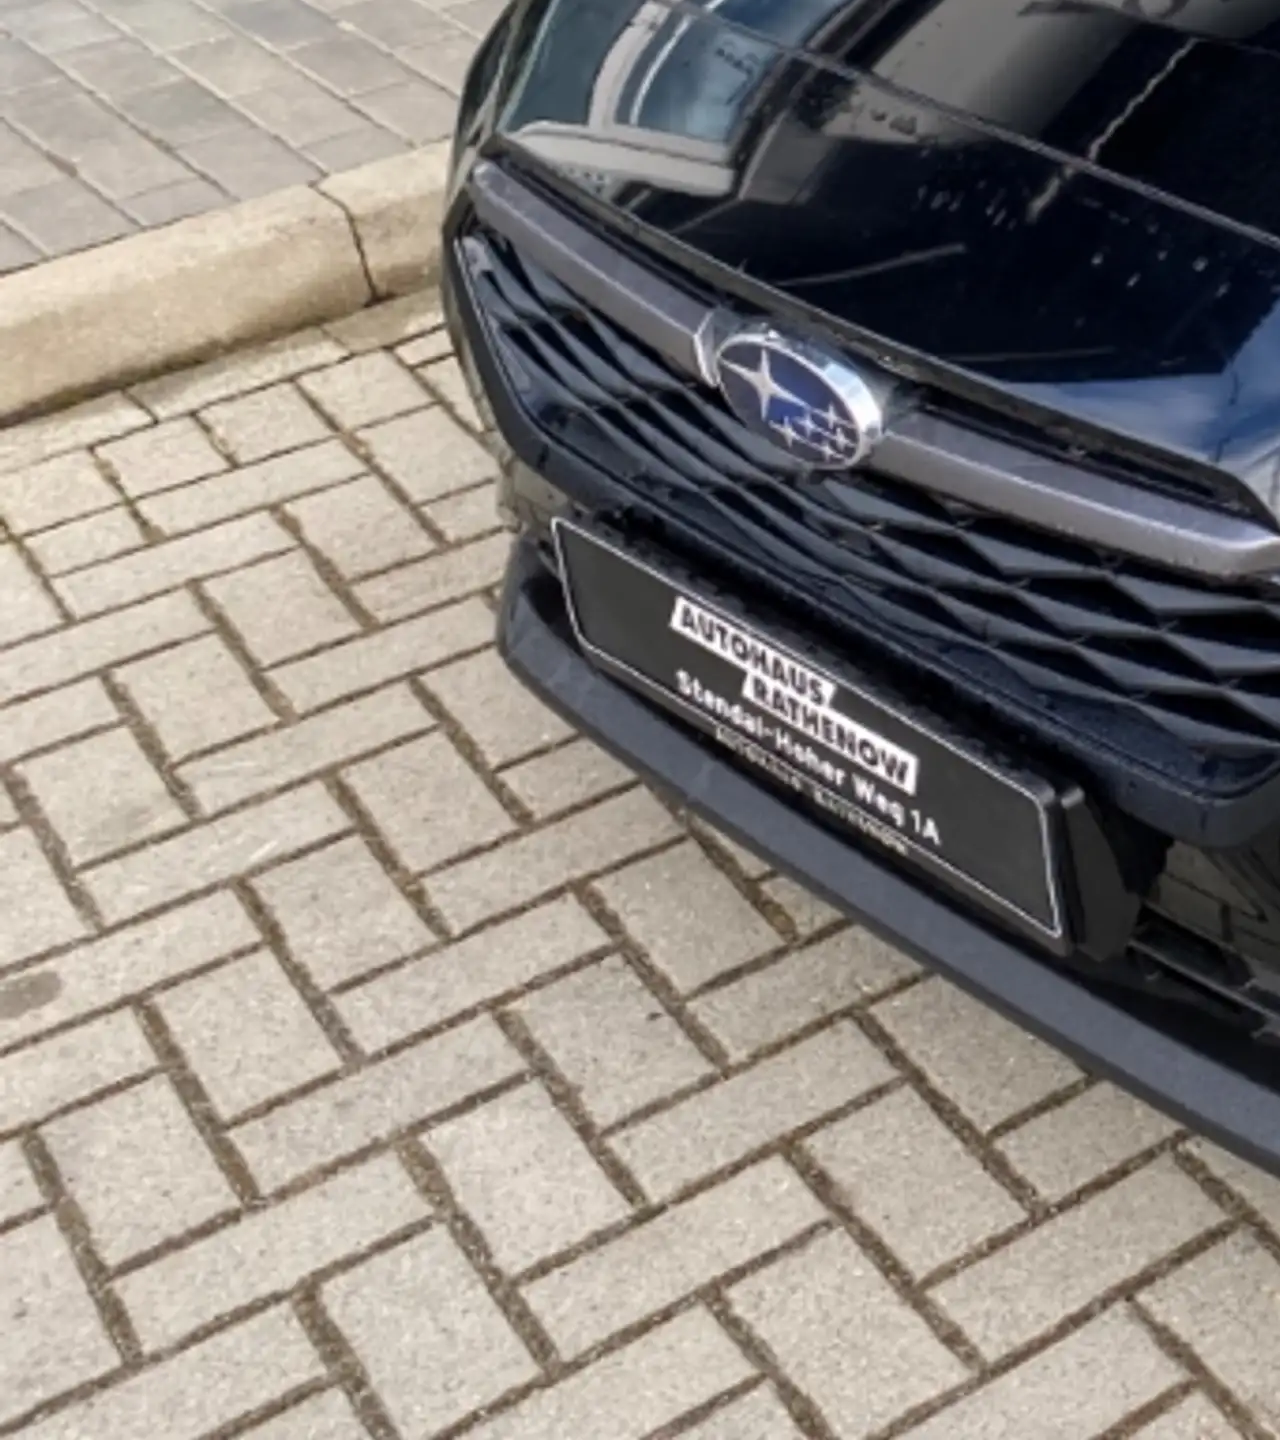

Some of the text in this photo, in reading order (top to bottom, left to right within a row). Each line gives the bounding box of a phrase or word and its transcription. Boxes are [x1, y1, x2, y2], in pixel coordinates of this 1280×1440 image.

[680, 604, 825, 707] AUTOHAUS
[751, 676, 910, 785] RATHENOW
[909, 809, 942, 847] 1A
